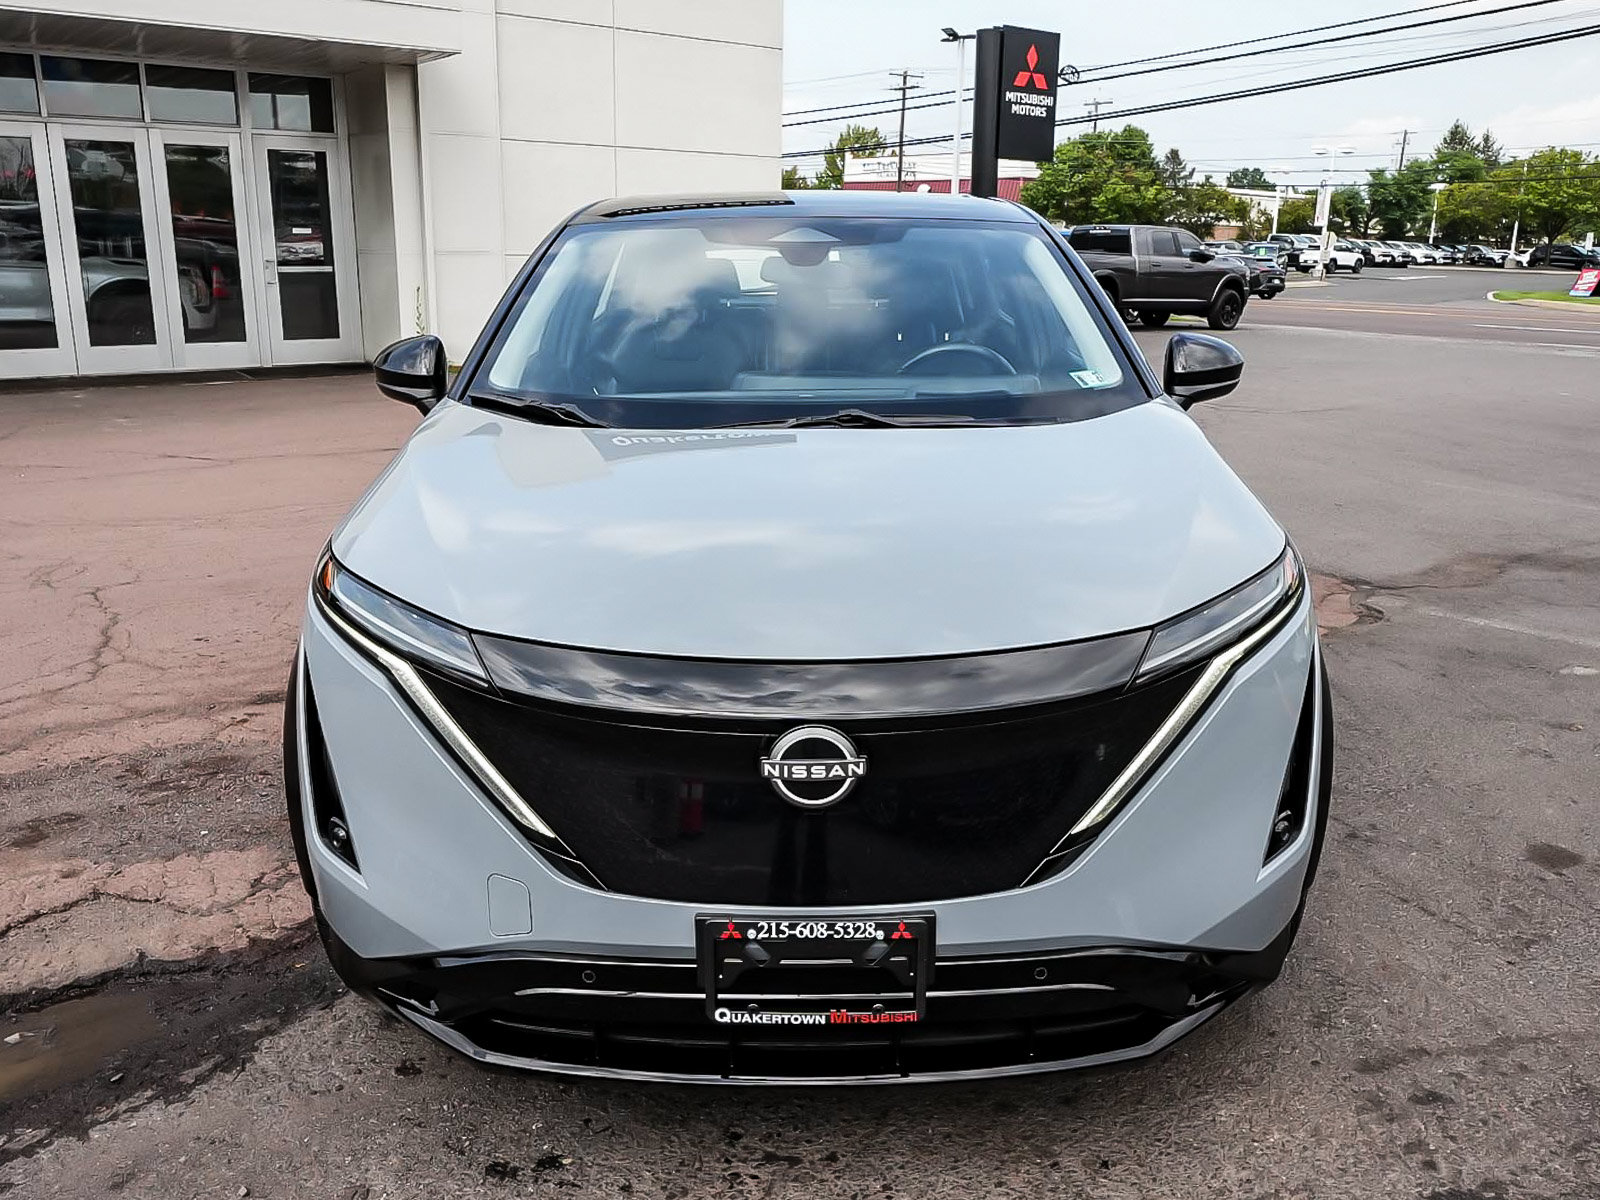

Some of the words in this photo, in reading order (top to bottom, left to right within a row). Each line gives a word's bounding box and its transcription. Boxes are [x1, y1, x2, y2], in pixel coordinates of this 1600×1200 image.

[1005, 91, 1054, 106] MITSUBISHI
[1011, 104, 1047, 117] MOTORS
[763, 762, 864, 779] NISSAN
[757, 921, 876, 939] 215-608-5328
[714, 1007, 826, 1025] QUAKERTOWN
[830, 1009, 918, 1024] MITSUBISHI
